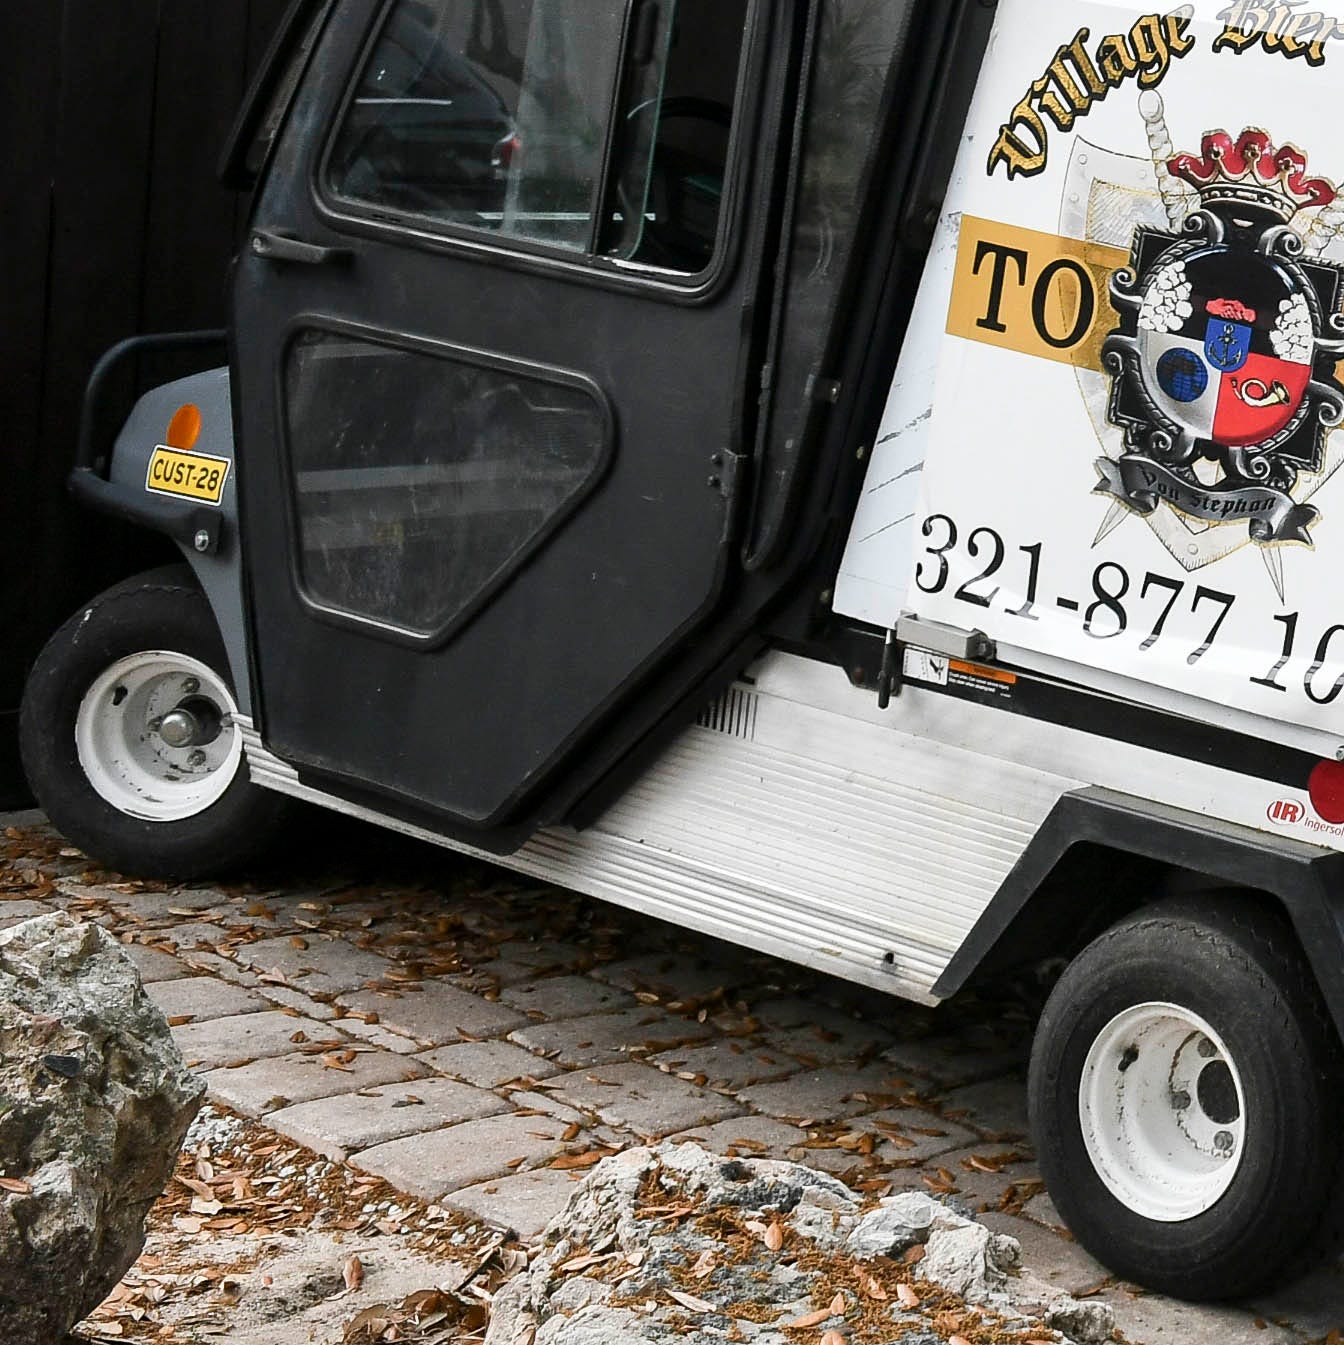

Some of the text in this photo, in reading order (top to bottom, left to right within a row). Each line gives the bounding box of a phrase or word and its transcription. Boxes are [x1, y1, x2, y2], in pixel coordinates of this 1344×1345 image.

[987, 3, 1196, 181] Village
[972, 240, 1096, 349] TO
[154, 458, 219, 490] CUST-28
[915, 513, 1236, 665] 321-877
[1272, 801, 1299, 824] IR
